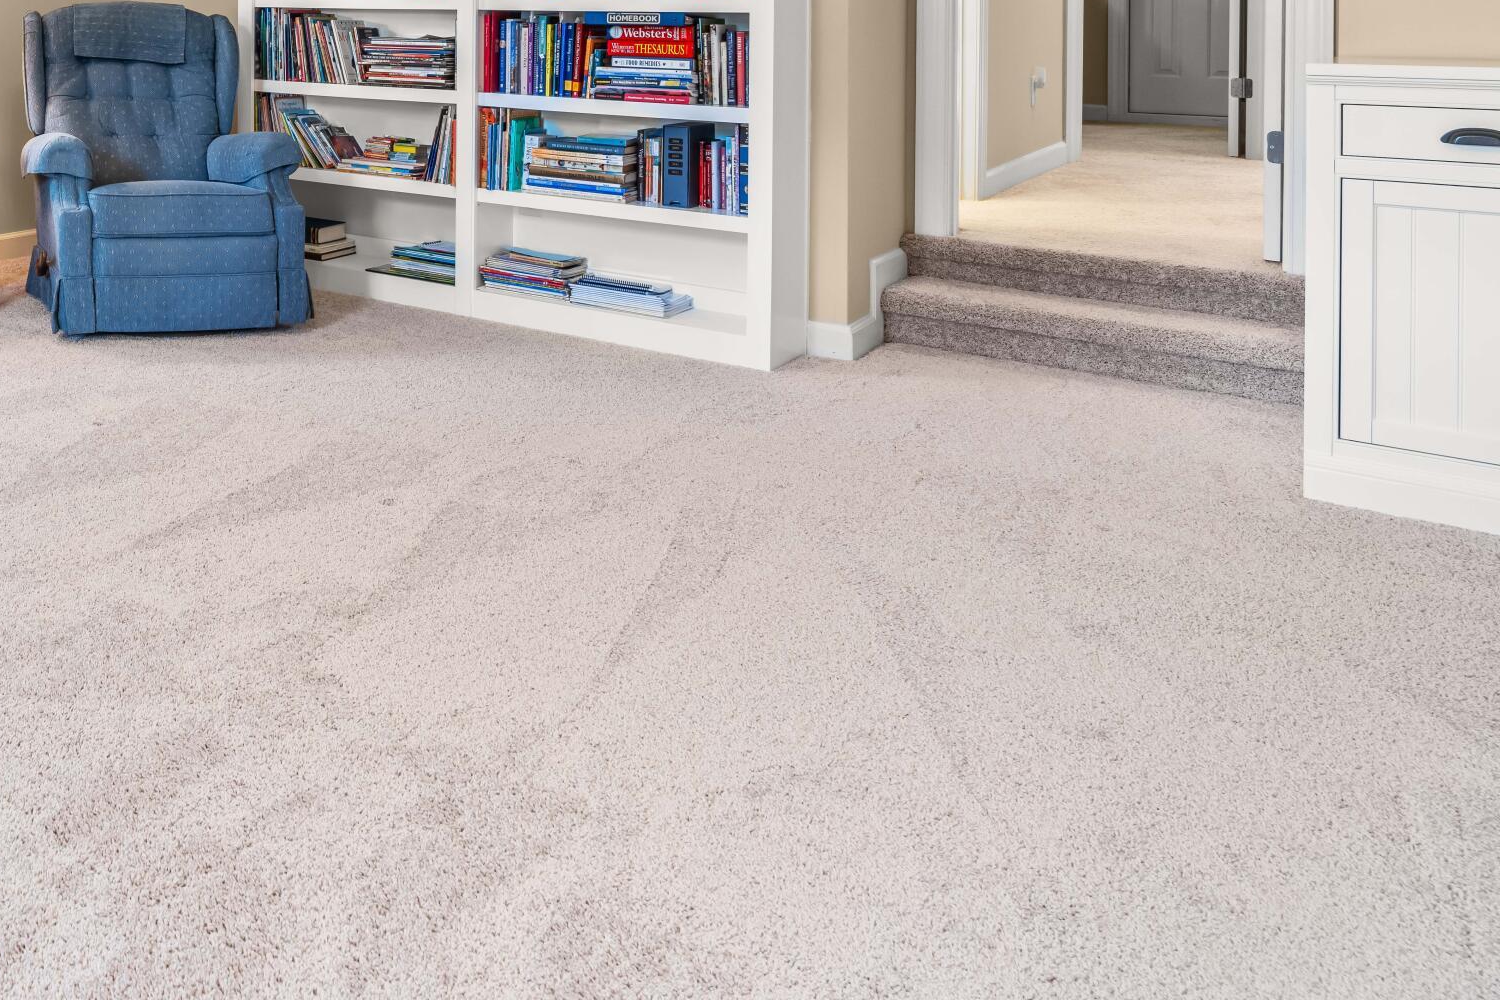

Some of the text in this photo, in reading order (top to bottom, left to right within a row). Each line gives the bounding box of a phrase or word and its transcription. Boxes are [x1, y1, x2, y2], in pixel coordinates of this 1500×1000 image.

[609, 14, 658, 22] HOMEBOOK
[623, 27, 672, 39] Webster's
[634, 43, 684, 55] THESAURUS
